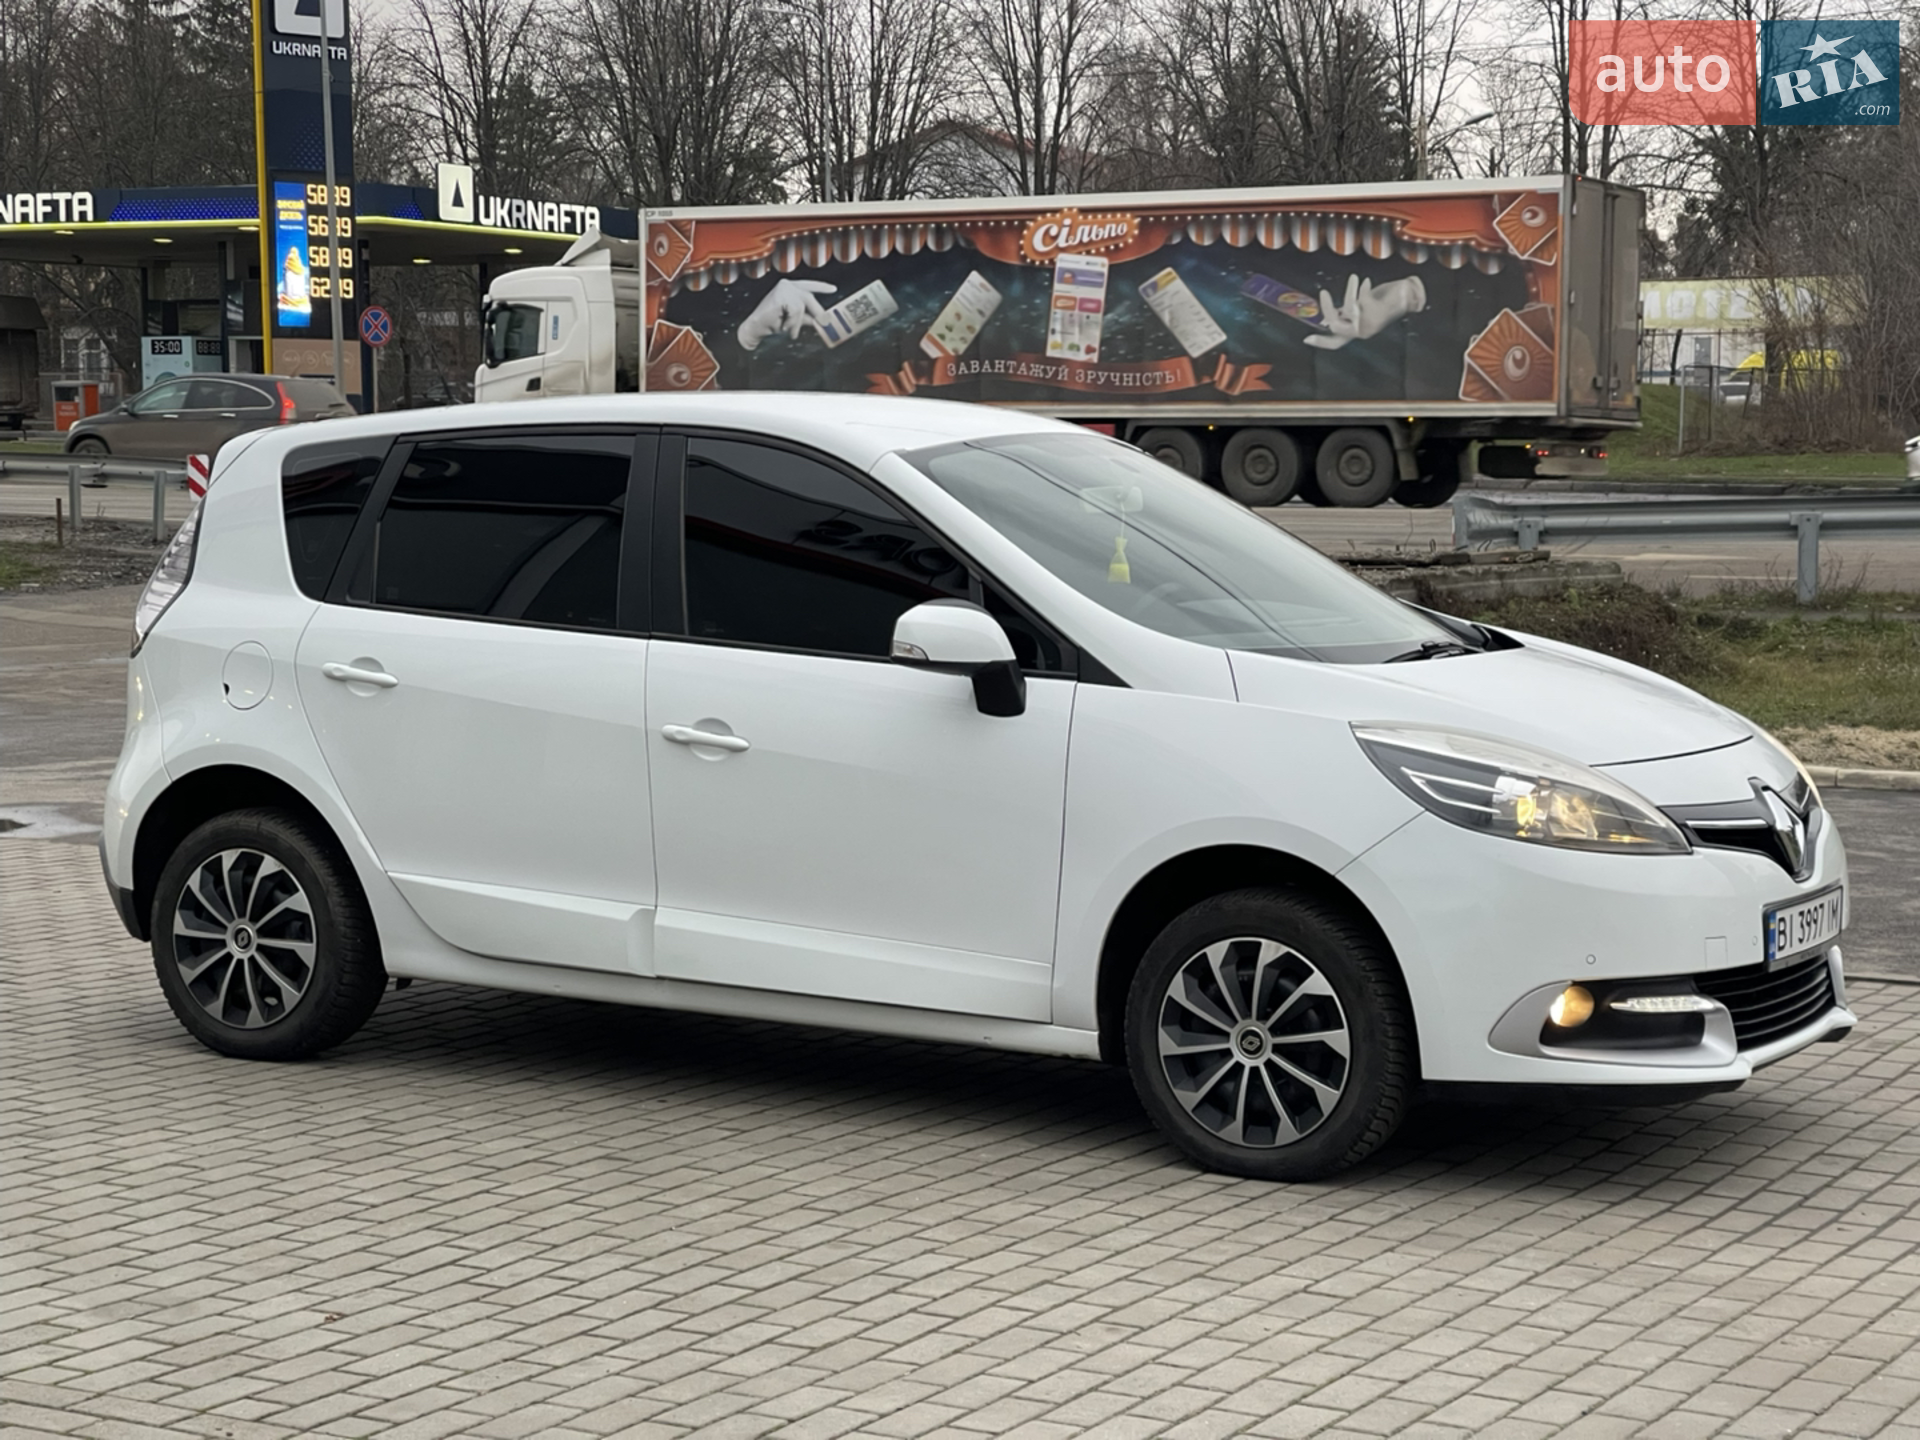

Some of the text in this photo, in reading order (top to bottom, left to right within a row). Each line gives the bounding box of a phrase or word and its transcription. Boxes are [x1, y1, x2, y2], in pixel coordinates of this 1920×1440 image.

[272, 40, 347, 60] UKRNATA
[478, 195, 600, 234] UKRNAFTA
[1032, 218, 1128, 253] Сільпо
[947, 360, 1182, 387] ЗАВАНТАЖУЙ ЗРУЧНІСТЬ!
[1797, 902, 1825, 944] 3997
[1827, 896, 1839, 933] IM
